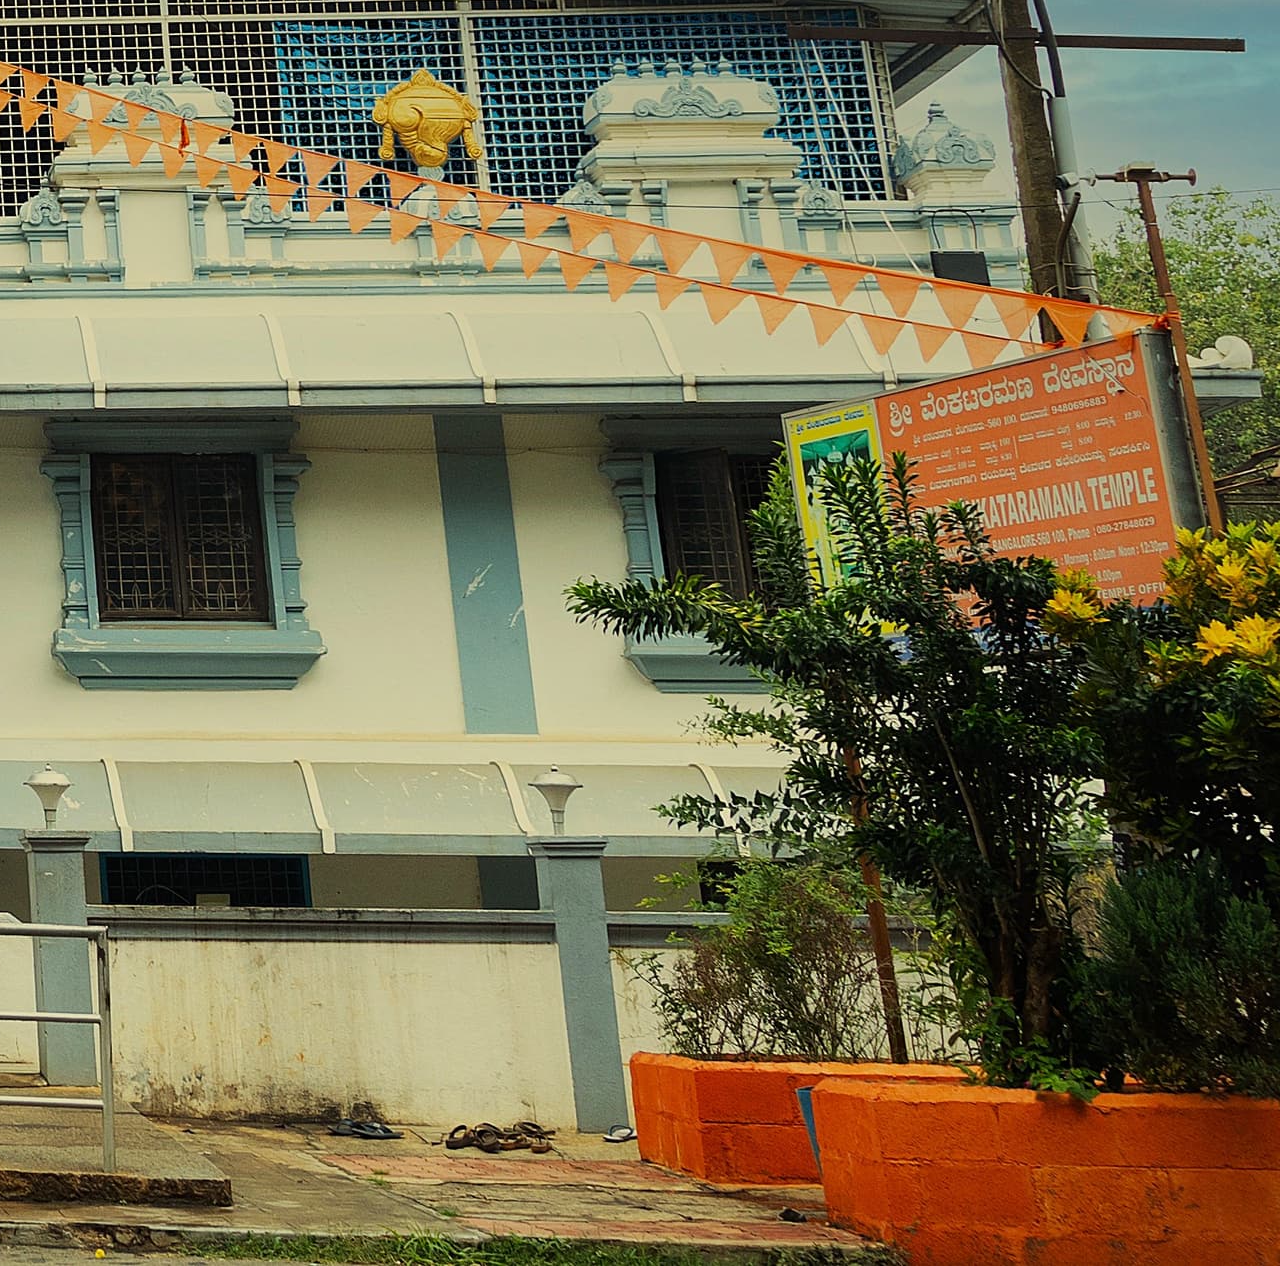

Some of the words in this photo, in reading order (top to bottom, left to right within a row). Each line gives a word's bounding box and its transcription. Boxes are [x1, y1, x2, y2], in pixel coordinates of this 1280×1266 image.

[889, 400, 913, 437] ಶ್ರೀ
[919, 376, 1034, 420] ವೆಂಕಟರಮಣ
[952, 482, 1088, 532] KATARAMANA
[1088, 466, 1159, 511] TEMPLE
